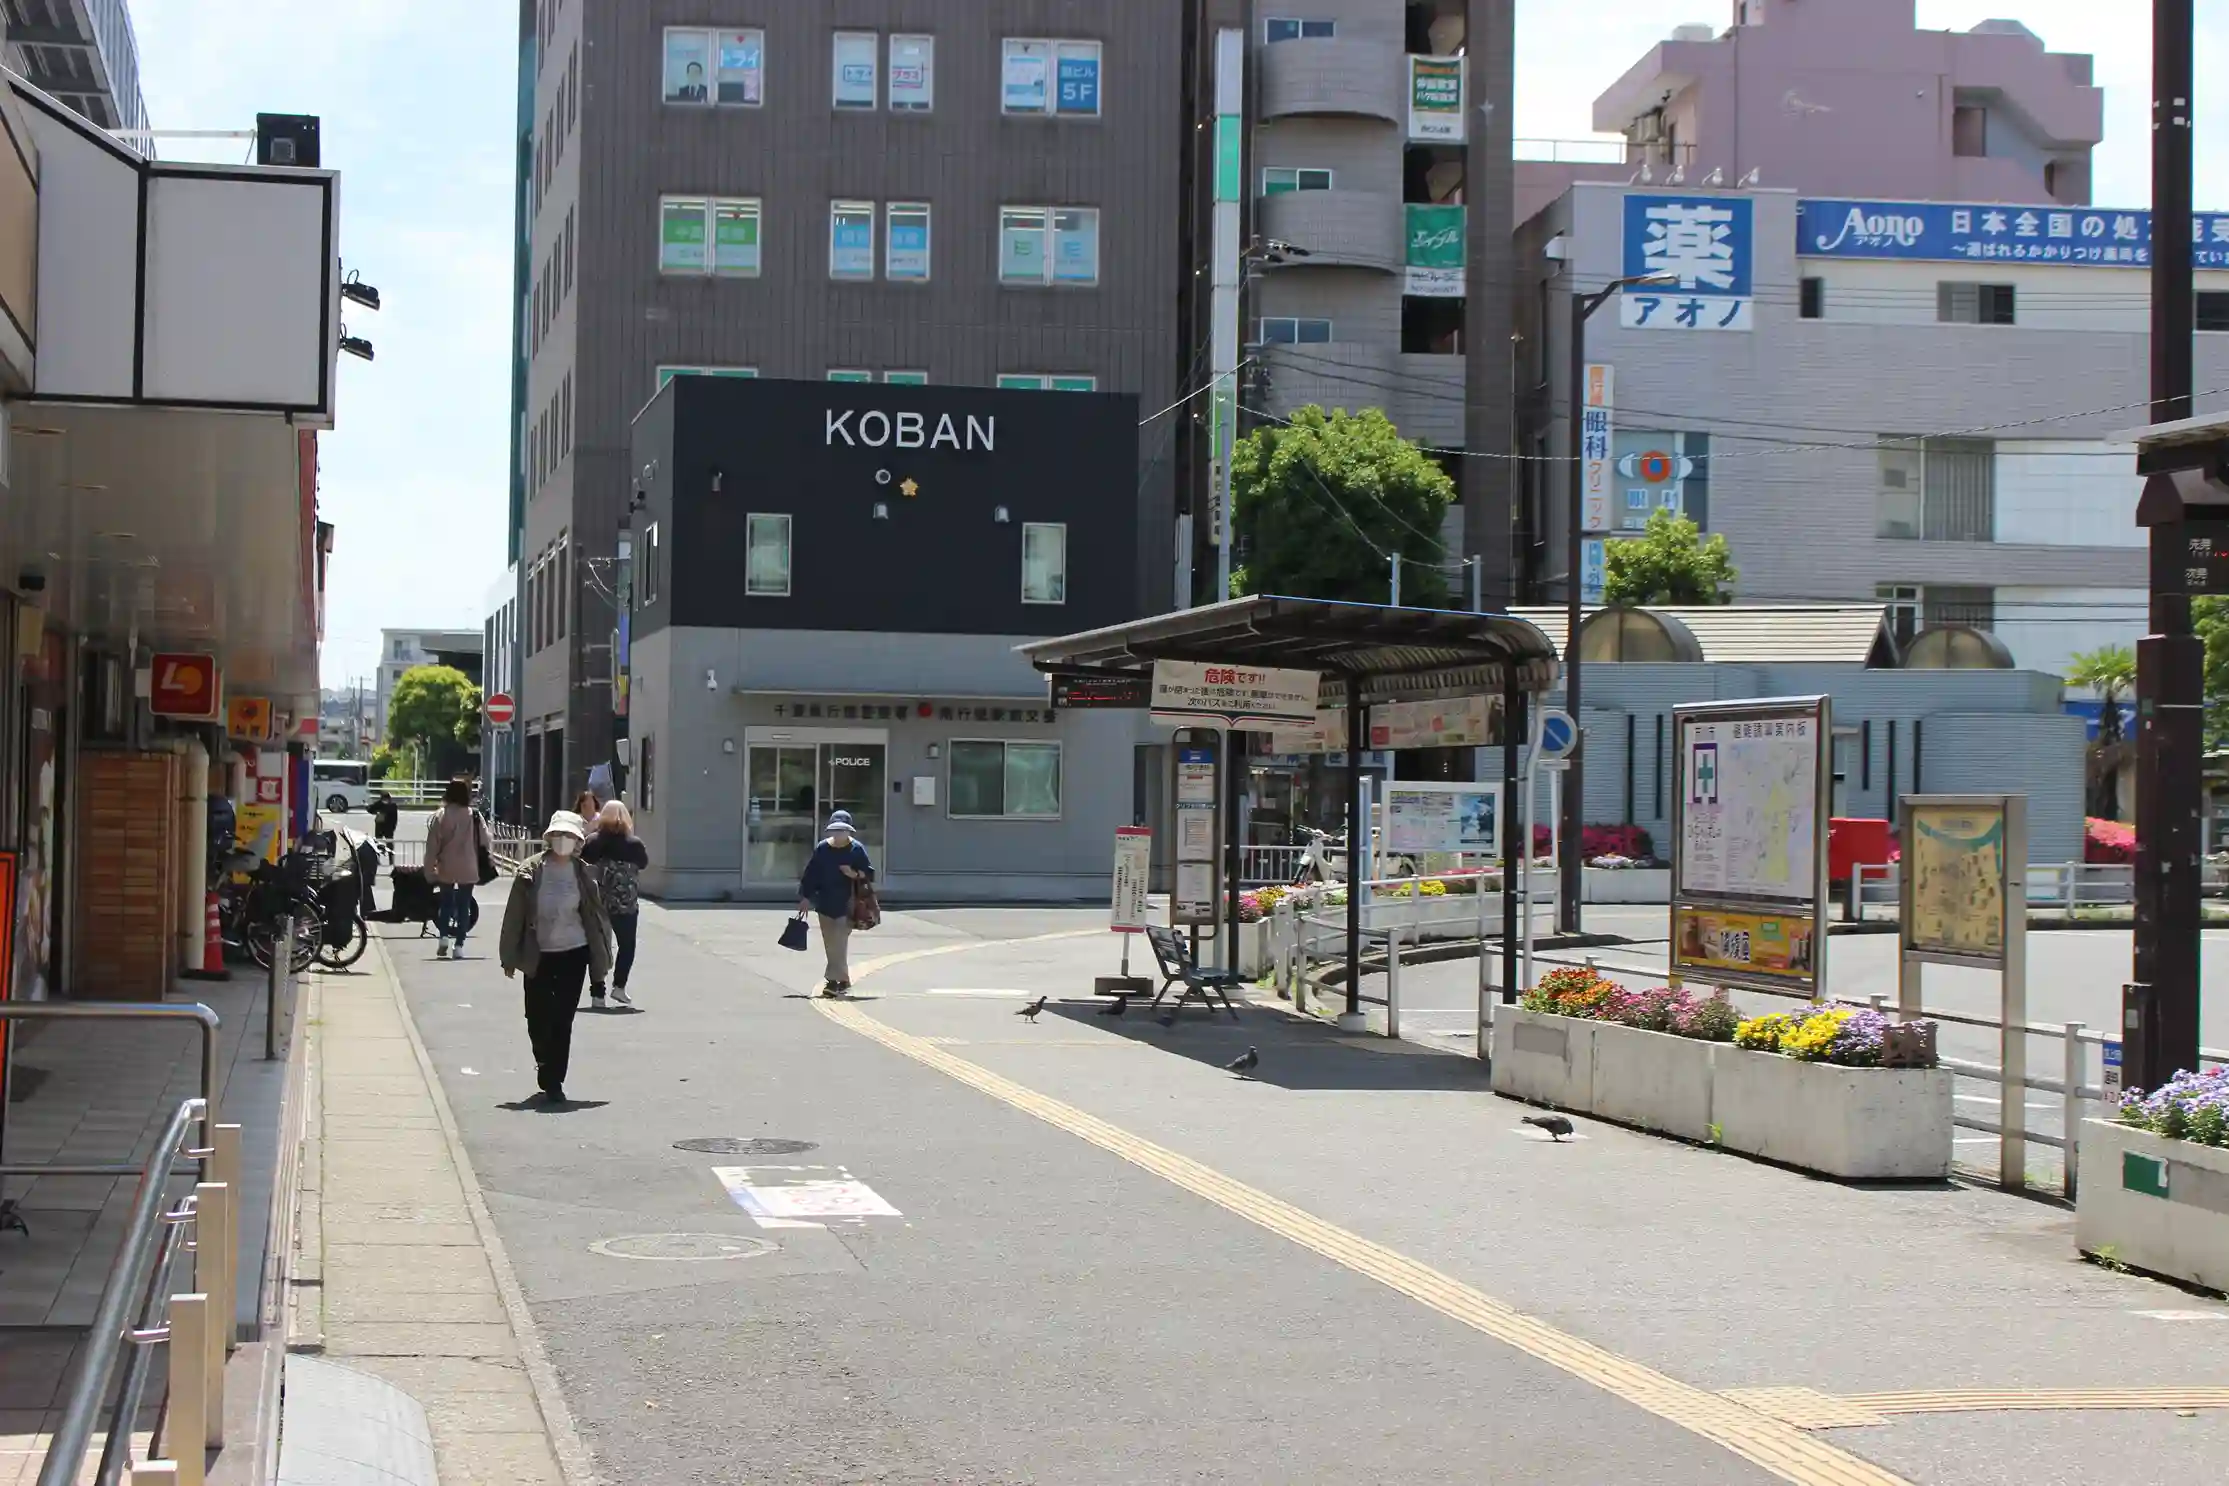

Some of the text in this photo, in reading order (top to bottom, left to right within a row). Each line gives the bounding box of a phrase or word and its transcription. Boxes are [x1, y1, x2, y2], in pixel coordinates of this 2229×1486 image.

[1063, 83, 1094, 101] 5F
[1816, 208, 1924, 250] Aono
[1952, 209, 2229, 243] 日本全国の処受
[1641, 204, 1735, 289] 薬
[1634, 298, 1741, 327] アオノ
[826, 408, 995, 452] KOBAN
[835, 757, 870, 766] POLICE
